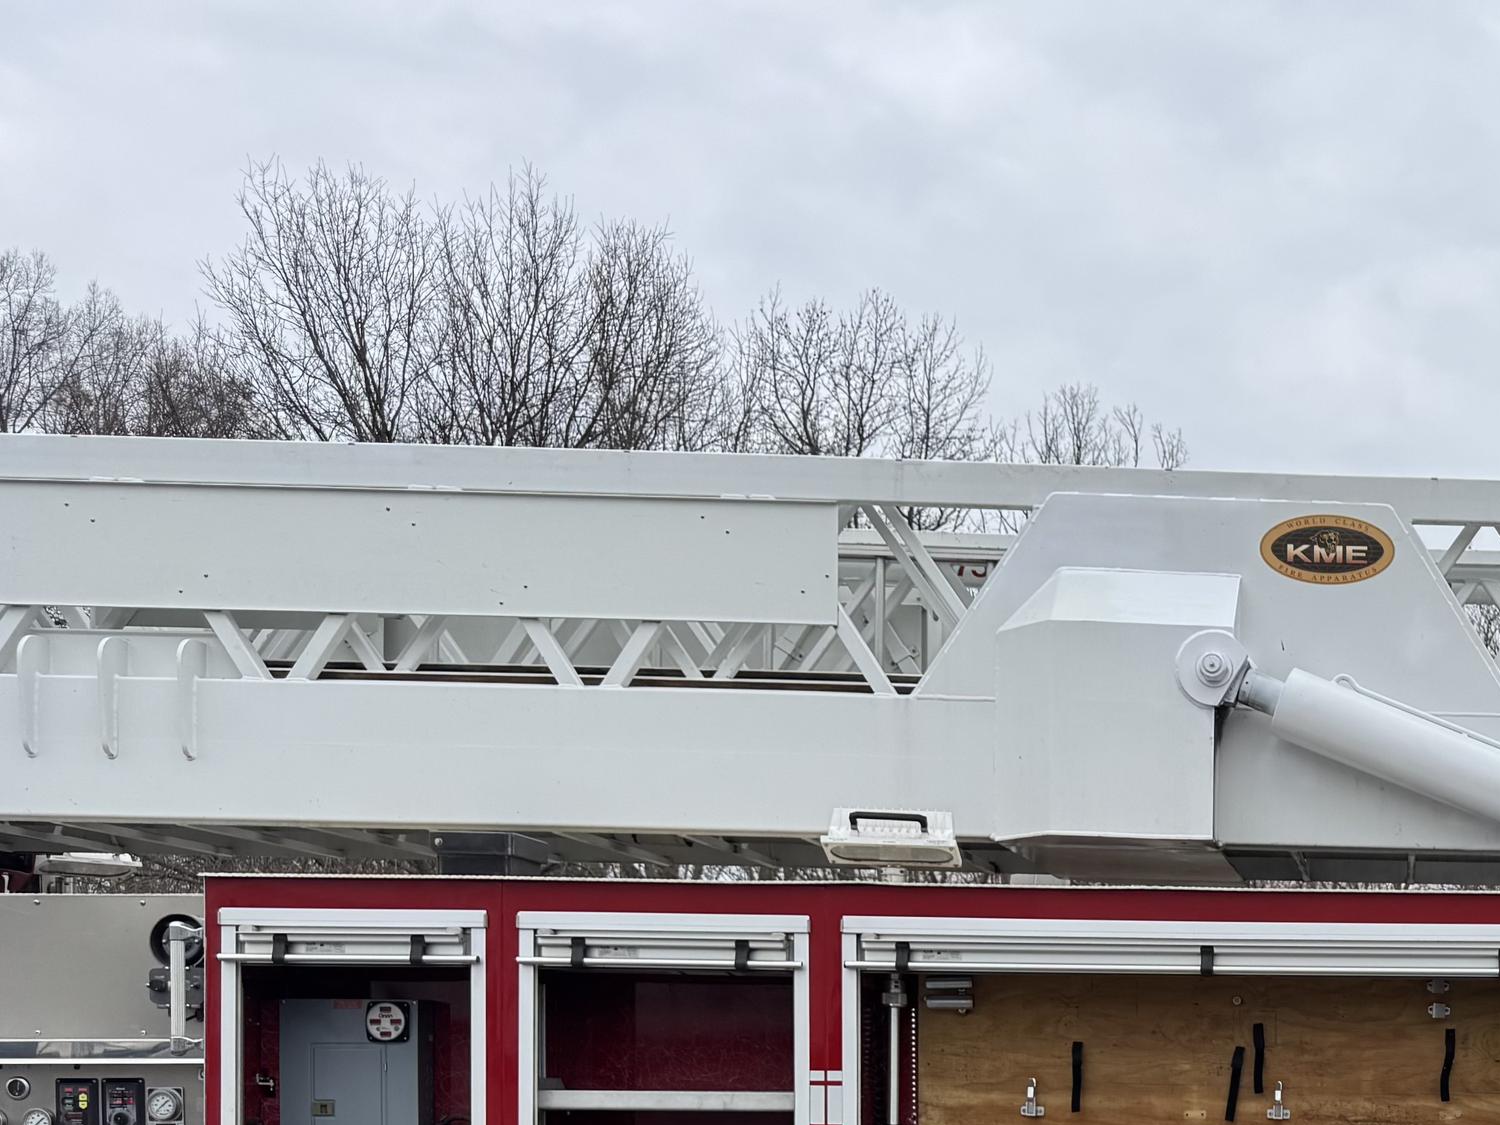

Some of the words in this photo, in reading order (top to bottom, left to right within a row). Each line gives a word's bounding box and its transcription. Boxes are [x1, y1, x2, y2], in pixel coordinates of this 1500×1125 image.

[1286, 516, 1326, 529] WORLD
[1335, 517, 1369, 532] CLASS
[1286, 543, 1368, 565] KME
[1278, 563, 1303, 579] FIRE
[1312, 567, 1377, 583] APPARATUS
